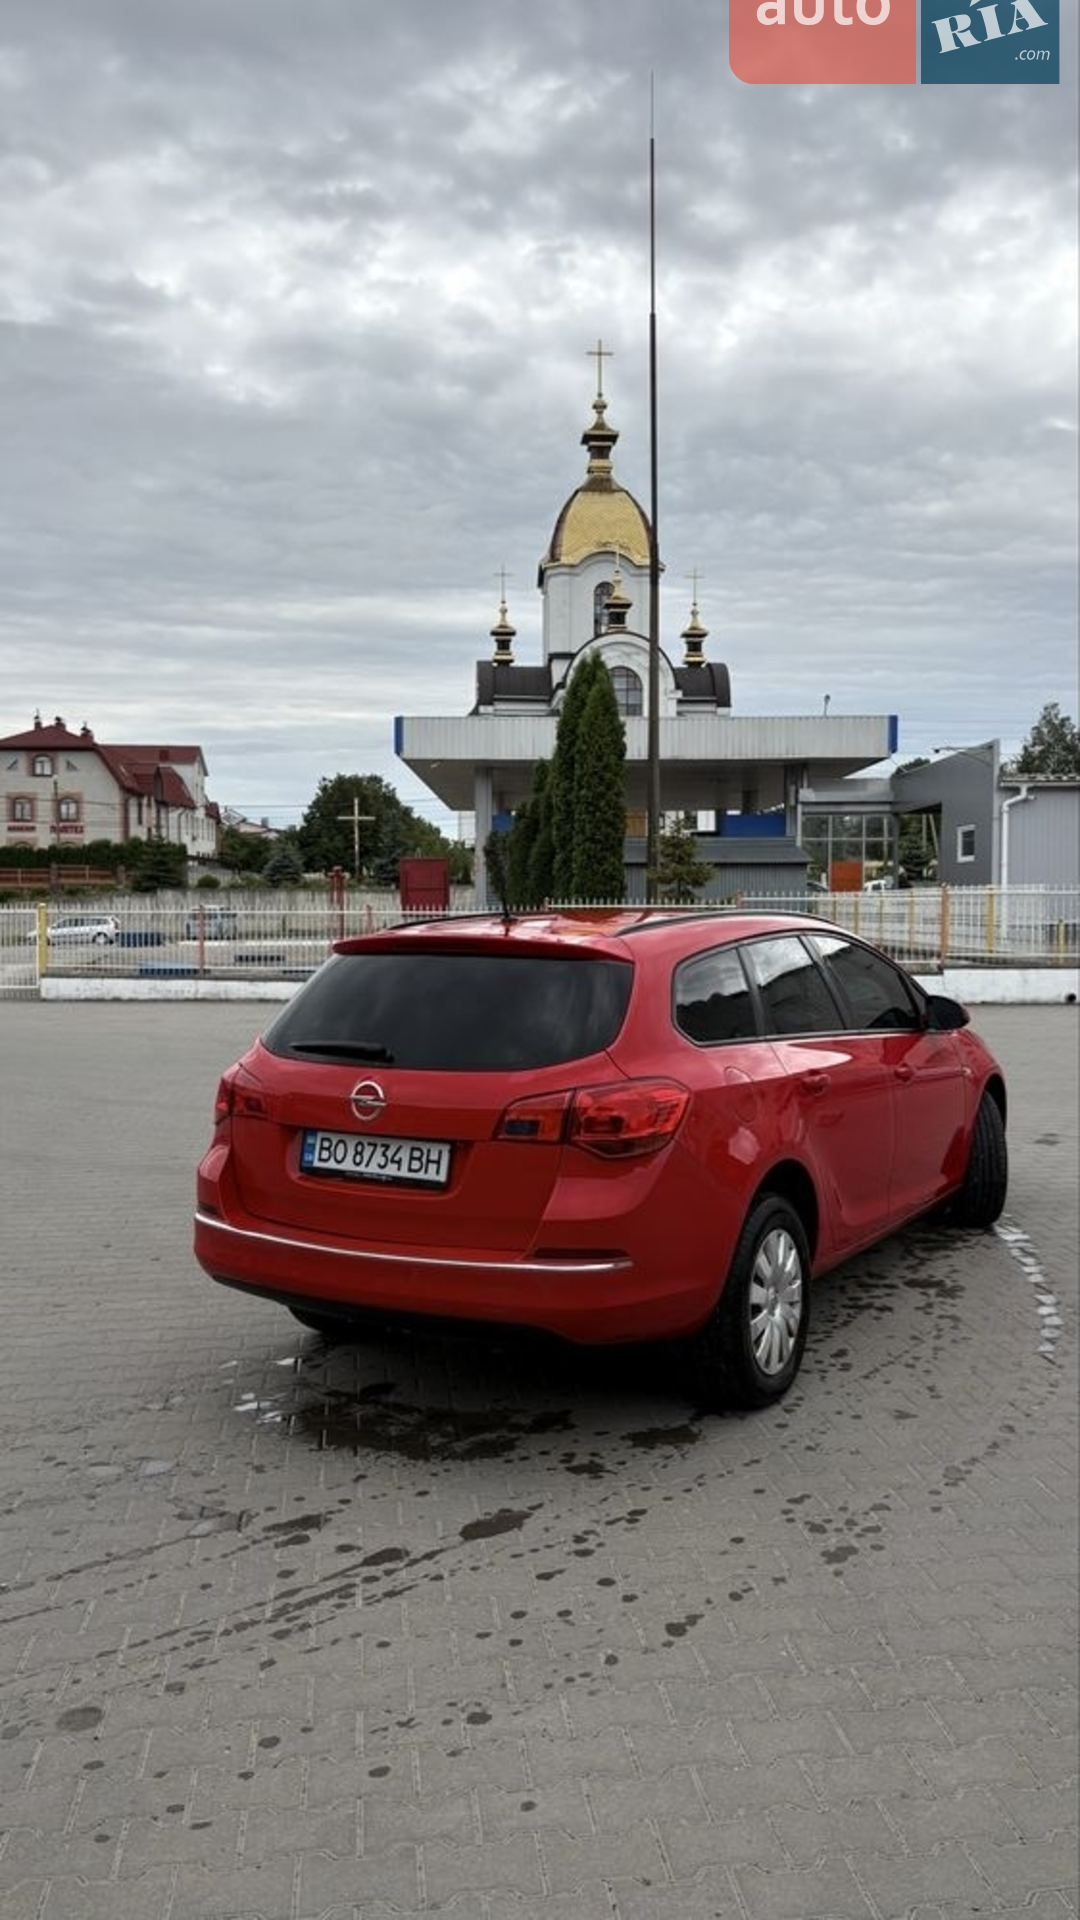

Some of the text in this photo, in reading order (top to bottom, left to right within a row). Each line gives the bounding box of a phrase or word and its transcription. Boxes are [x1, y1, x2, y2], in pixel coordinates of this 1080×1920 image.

[318, 1137, 443, 1176] BO 8734 BH
